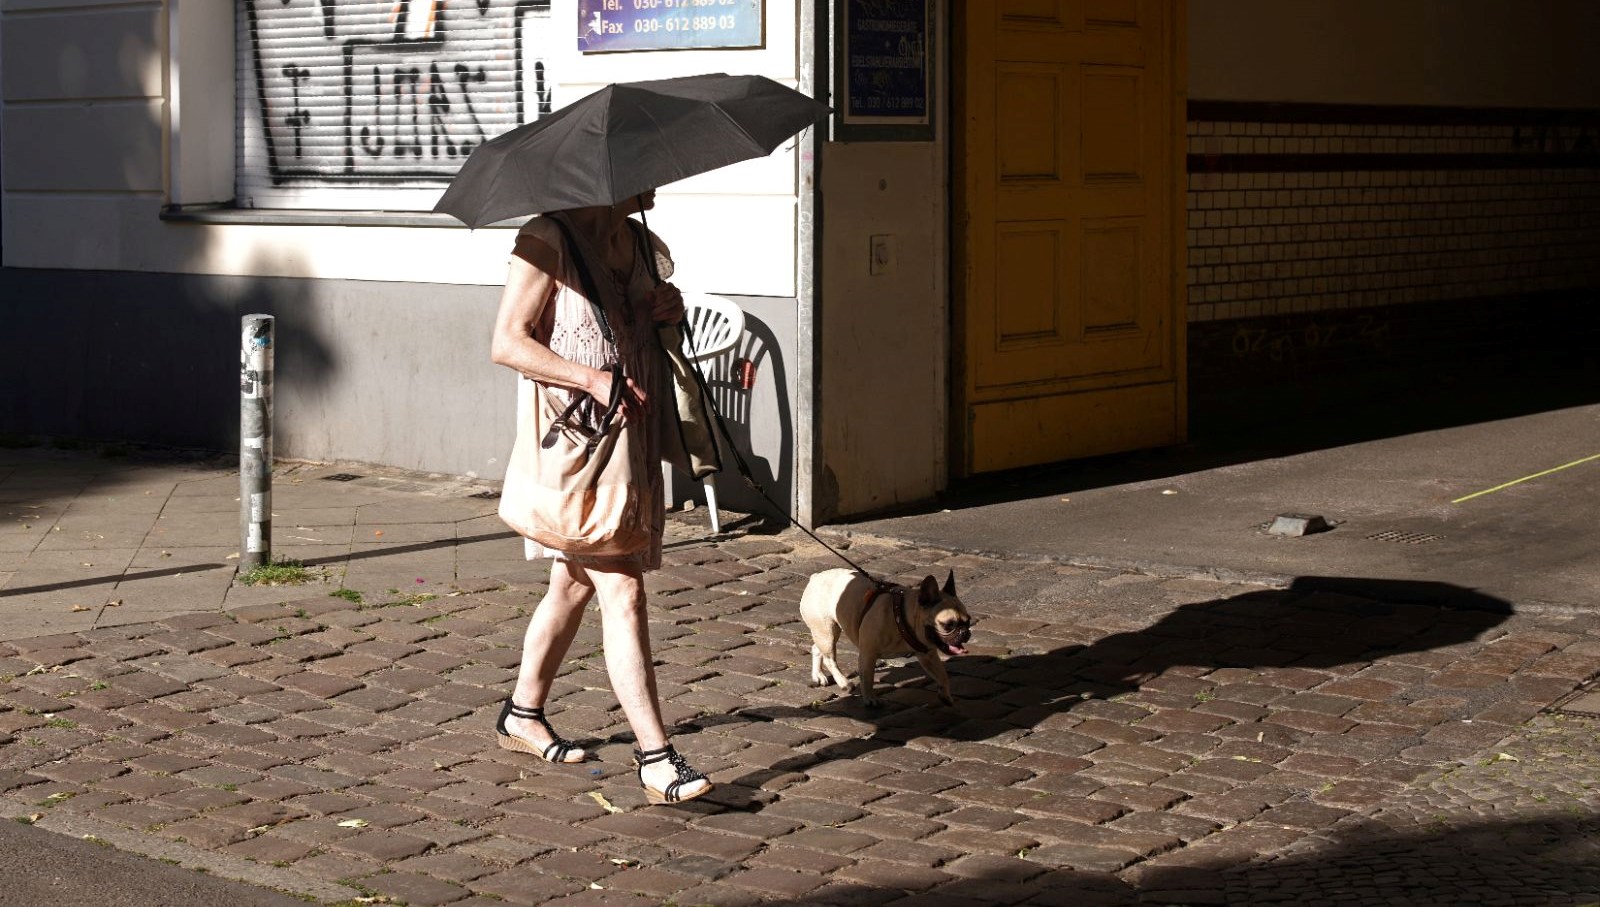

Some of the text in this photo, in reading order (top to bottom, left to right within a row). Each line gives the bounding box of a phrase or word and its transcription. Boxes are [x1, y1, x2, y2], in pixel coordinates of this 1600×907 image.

[601, 15, 736, 34] Fax 030- 612 889 03
[887, 96, 900, 109] 612
